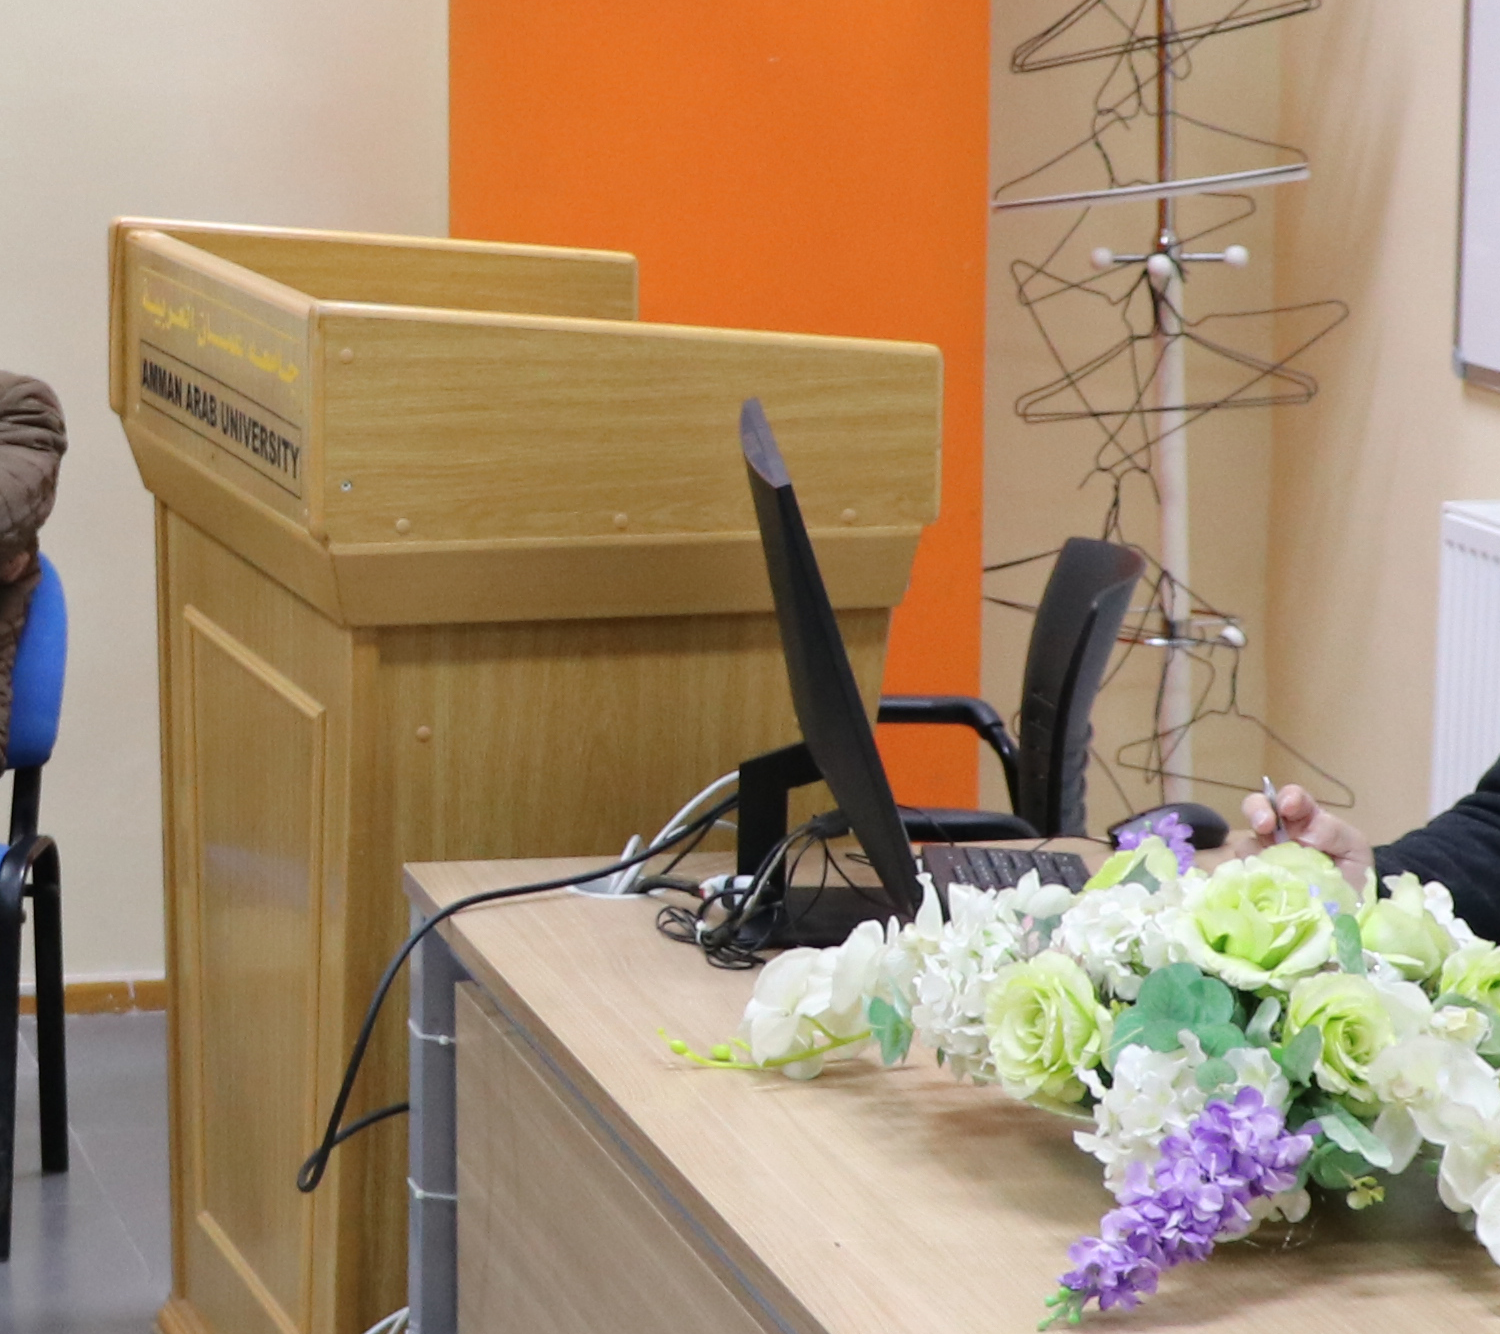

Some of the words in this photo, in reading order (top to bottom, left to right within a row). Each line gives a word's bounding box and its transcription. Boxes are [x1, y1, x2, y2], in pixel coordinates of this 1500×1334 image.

[142, 358, 183, 408] AMMAN
[186, 381, 218, 429] ARAB
[220, 401, 300, 479] UNIVERSITY
